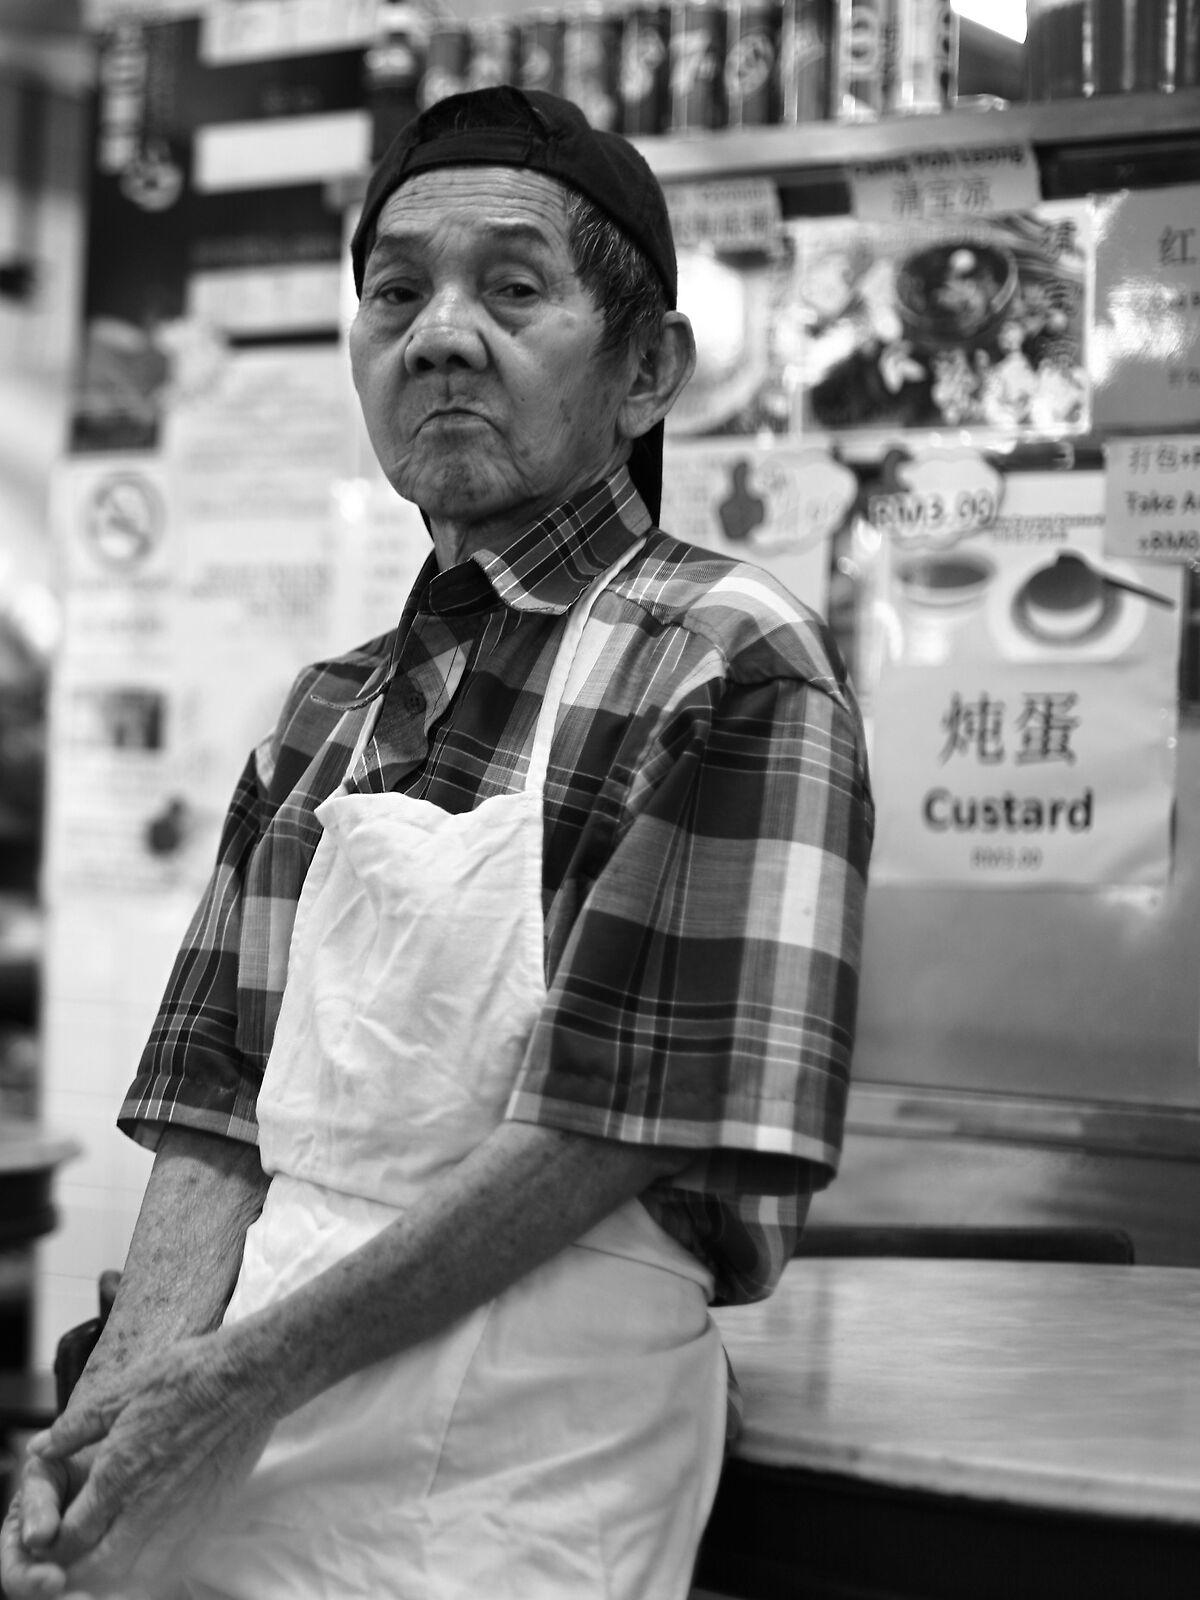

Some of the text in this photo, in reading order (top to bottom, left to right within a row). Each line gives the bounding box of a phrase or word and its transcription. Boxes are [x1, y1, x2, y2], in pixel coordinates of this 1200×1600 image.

[1124, 489, 1200, 517] Take A
[937, 690, 1082, 768] 炖蛋
[922, 785, 1094, 834] Custard
